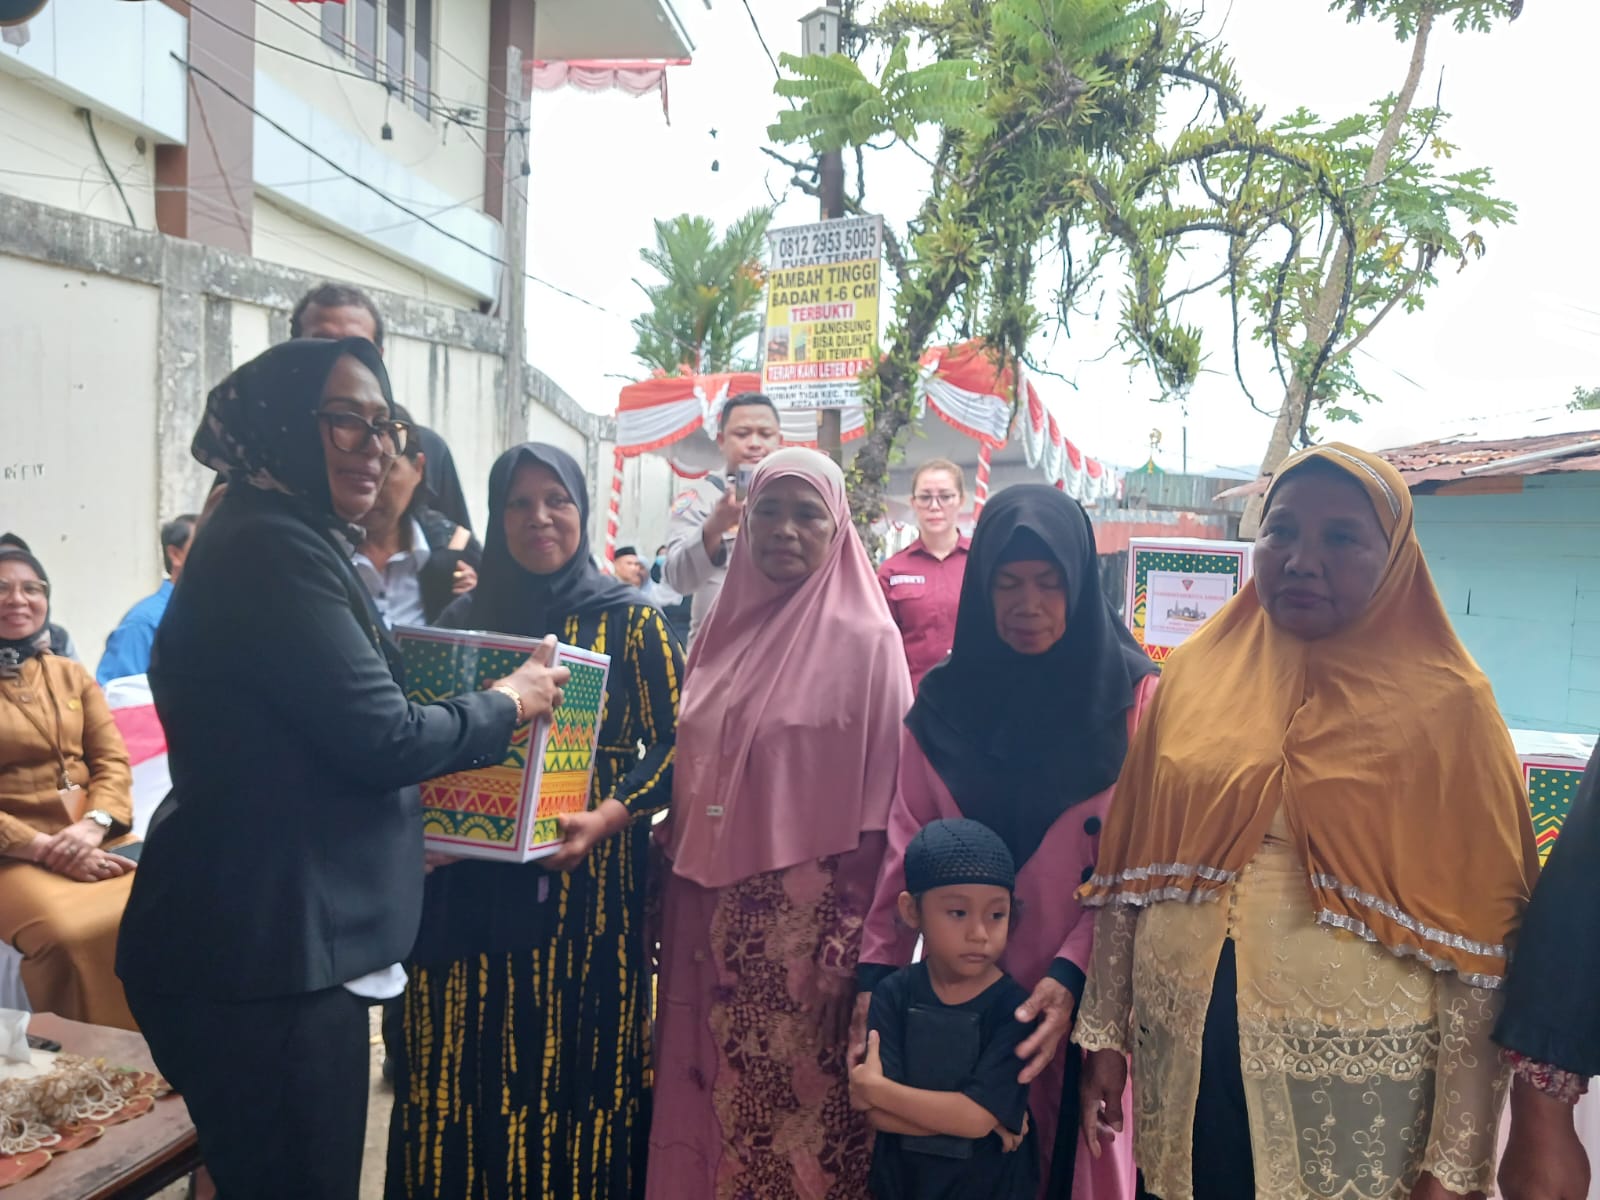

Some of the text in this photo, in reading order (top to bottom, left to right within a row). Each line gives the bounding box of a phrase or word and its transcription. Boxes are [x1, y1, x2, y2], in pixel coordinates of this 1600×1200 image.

[779, 226, 877, 258] 0812 2953 5005
[781, 250, 873, 269] PUSAT TERAPI
[828, 263, 876, 284] TINGGI
[772, 282, 876, 308] BADAN 1-6 CM
[791, 304, 854, 322] TERBUKTI
[814, 320, 872, 335] LANGSUNG
[813, 333, 874, 349] BISA DILIHAT
[816, 347, 864, 361] DI TEMPAT
[767, 365, 797, 382] TERAPI
[818, 361, 846, 378] LETER
